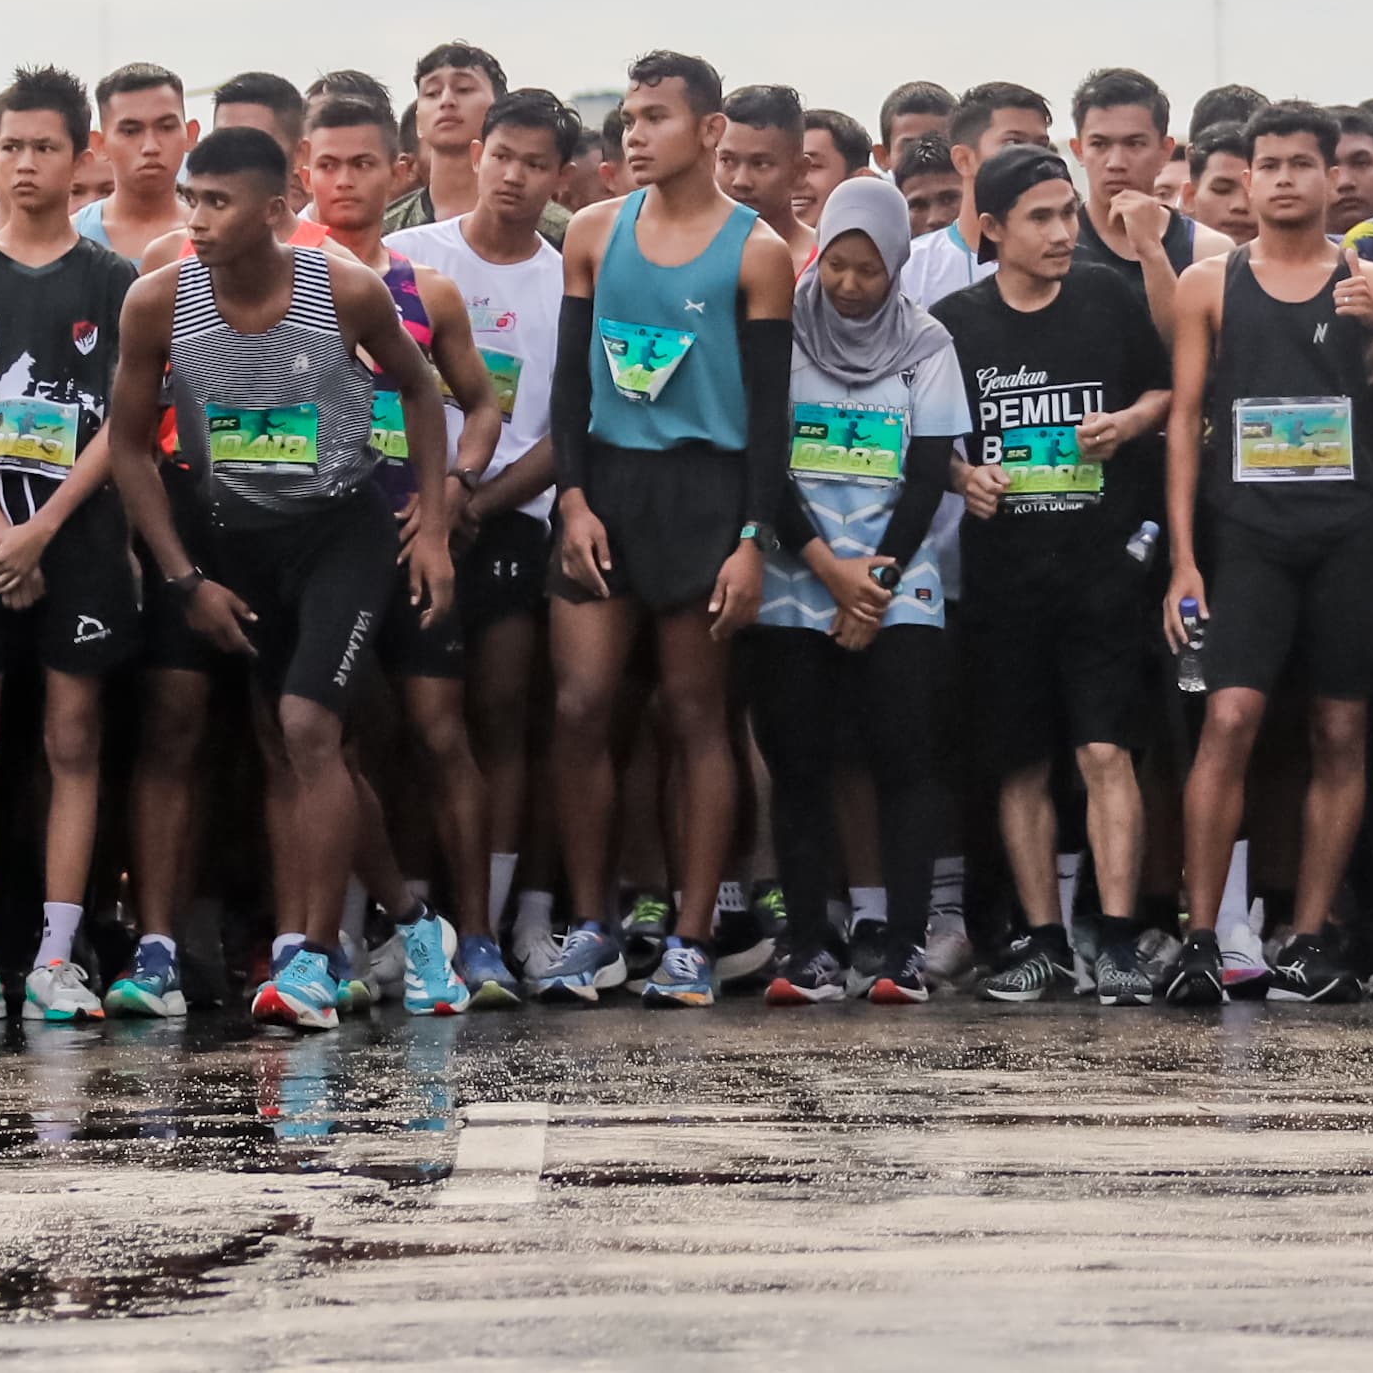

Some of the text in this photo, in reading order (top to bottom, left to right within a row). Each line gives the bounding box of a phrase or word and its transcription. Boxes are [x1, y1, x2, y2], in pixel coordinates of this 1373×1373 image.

[976, 365, 1048, 399] Gerakan
[979, 390, 1103, 431] PEMILU
[799, 425, 826, 436] 5K
